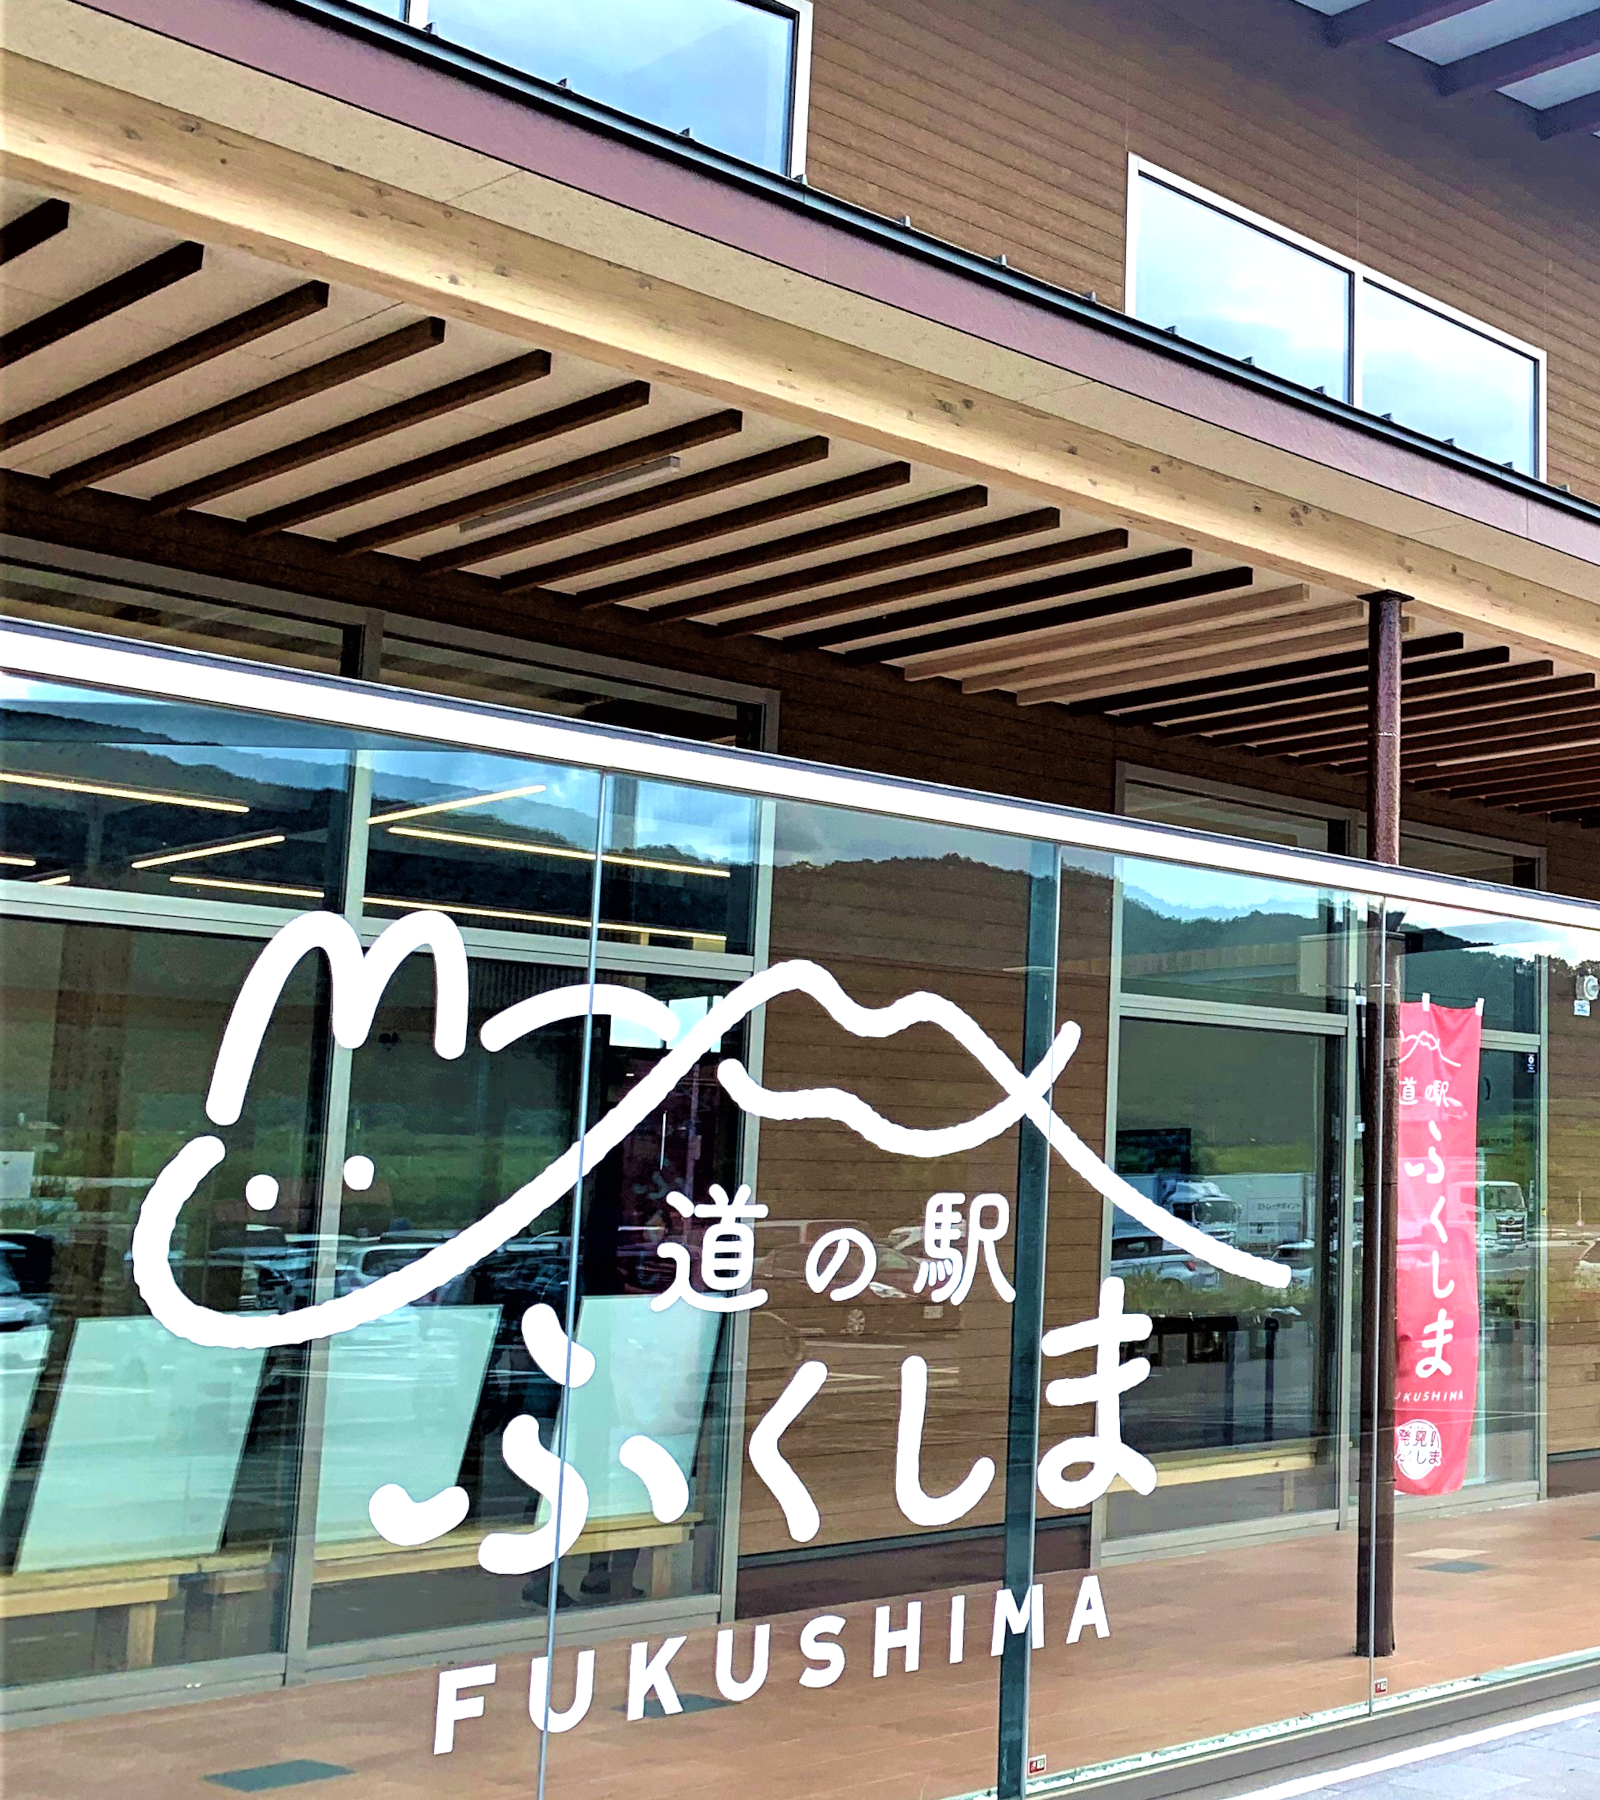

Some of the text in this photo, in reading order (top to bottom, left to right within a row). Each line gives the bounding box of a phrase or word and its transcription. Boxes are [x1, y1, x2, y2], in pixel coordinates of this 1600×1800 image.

[650, 1183, 1016, 1314] 道の駅
[1404, 1119, 1455, 1380] ふくしま
[367, 1276, 1159, 1575] ふくしま
[1394, 1390, 1464, 1402] UKUSHIMA
[433, 1575, 1110, 1756] FUKUSHIMA
